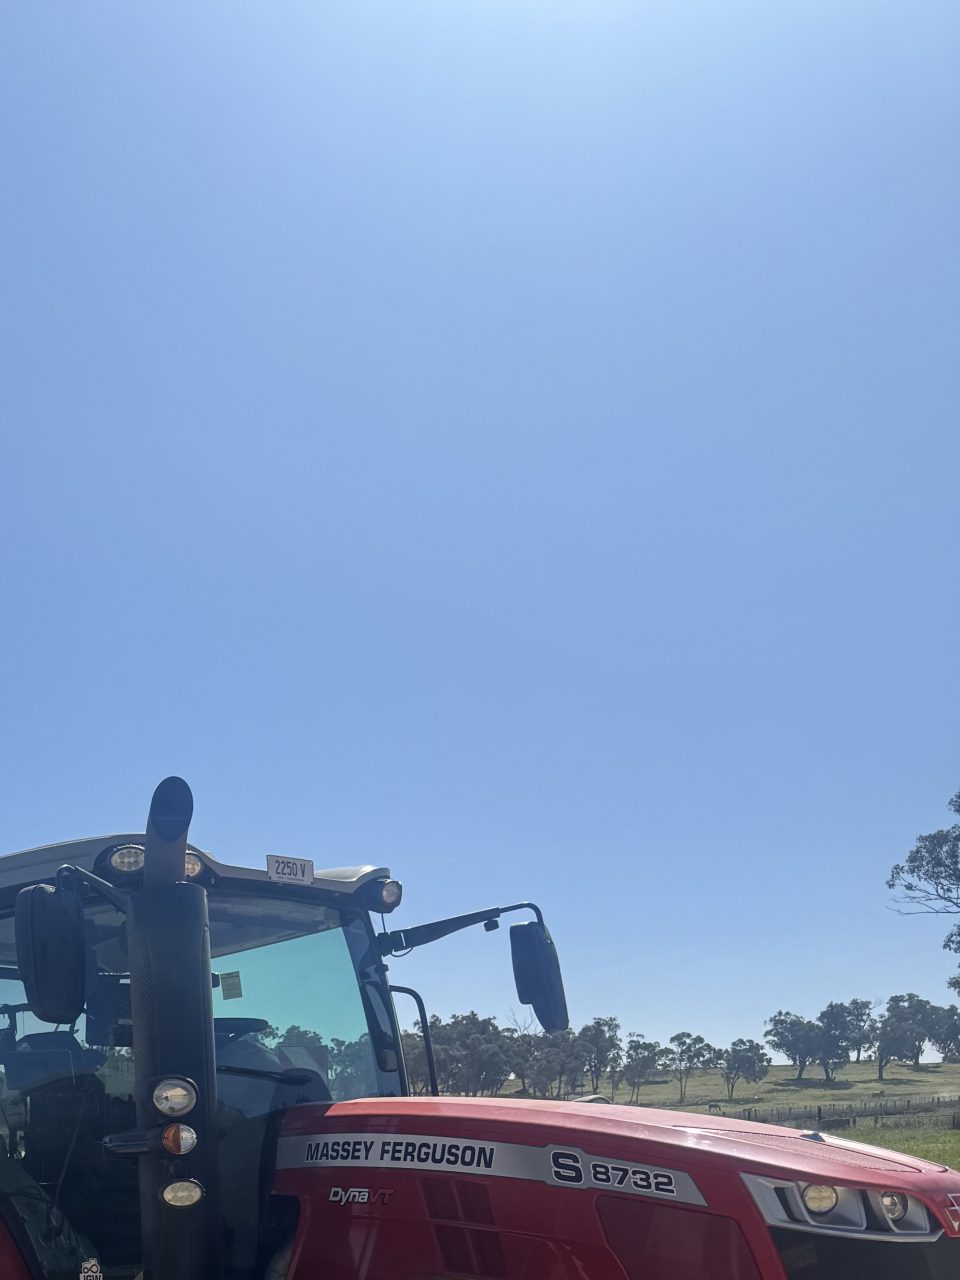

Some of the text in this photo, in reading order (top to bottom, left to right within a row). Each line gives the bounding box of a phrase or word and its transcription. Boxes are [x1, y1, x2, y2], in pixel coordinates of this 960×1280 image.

[275, 860, 298, 876] 2250
[305, 1140, 495, 1168] MASSEY FERGUSON
[551, 1150, 676, 1196] S 8732
